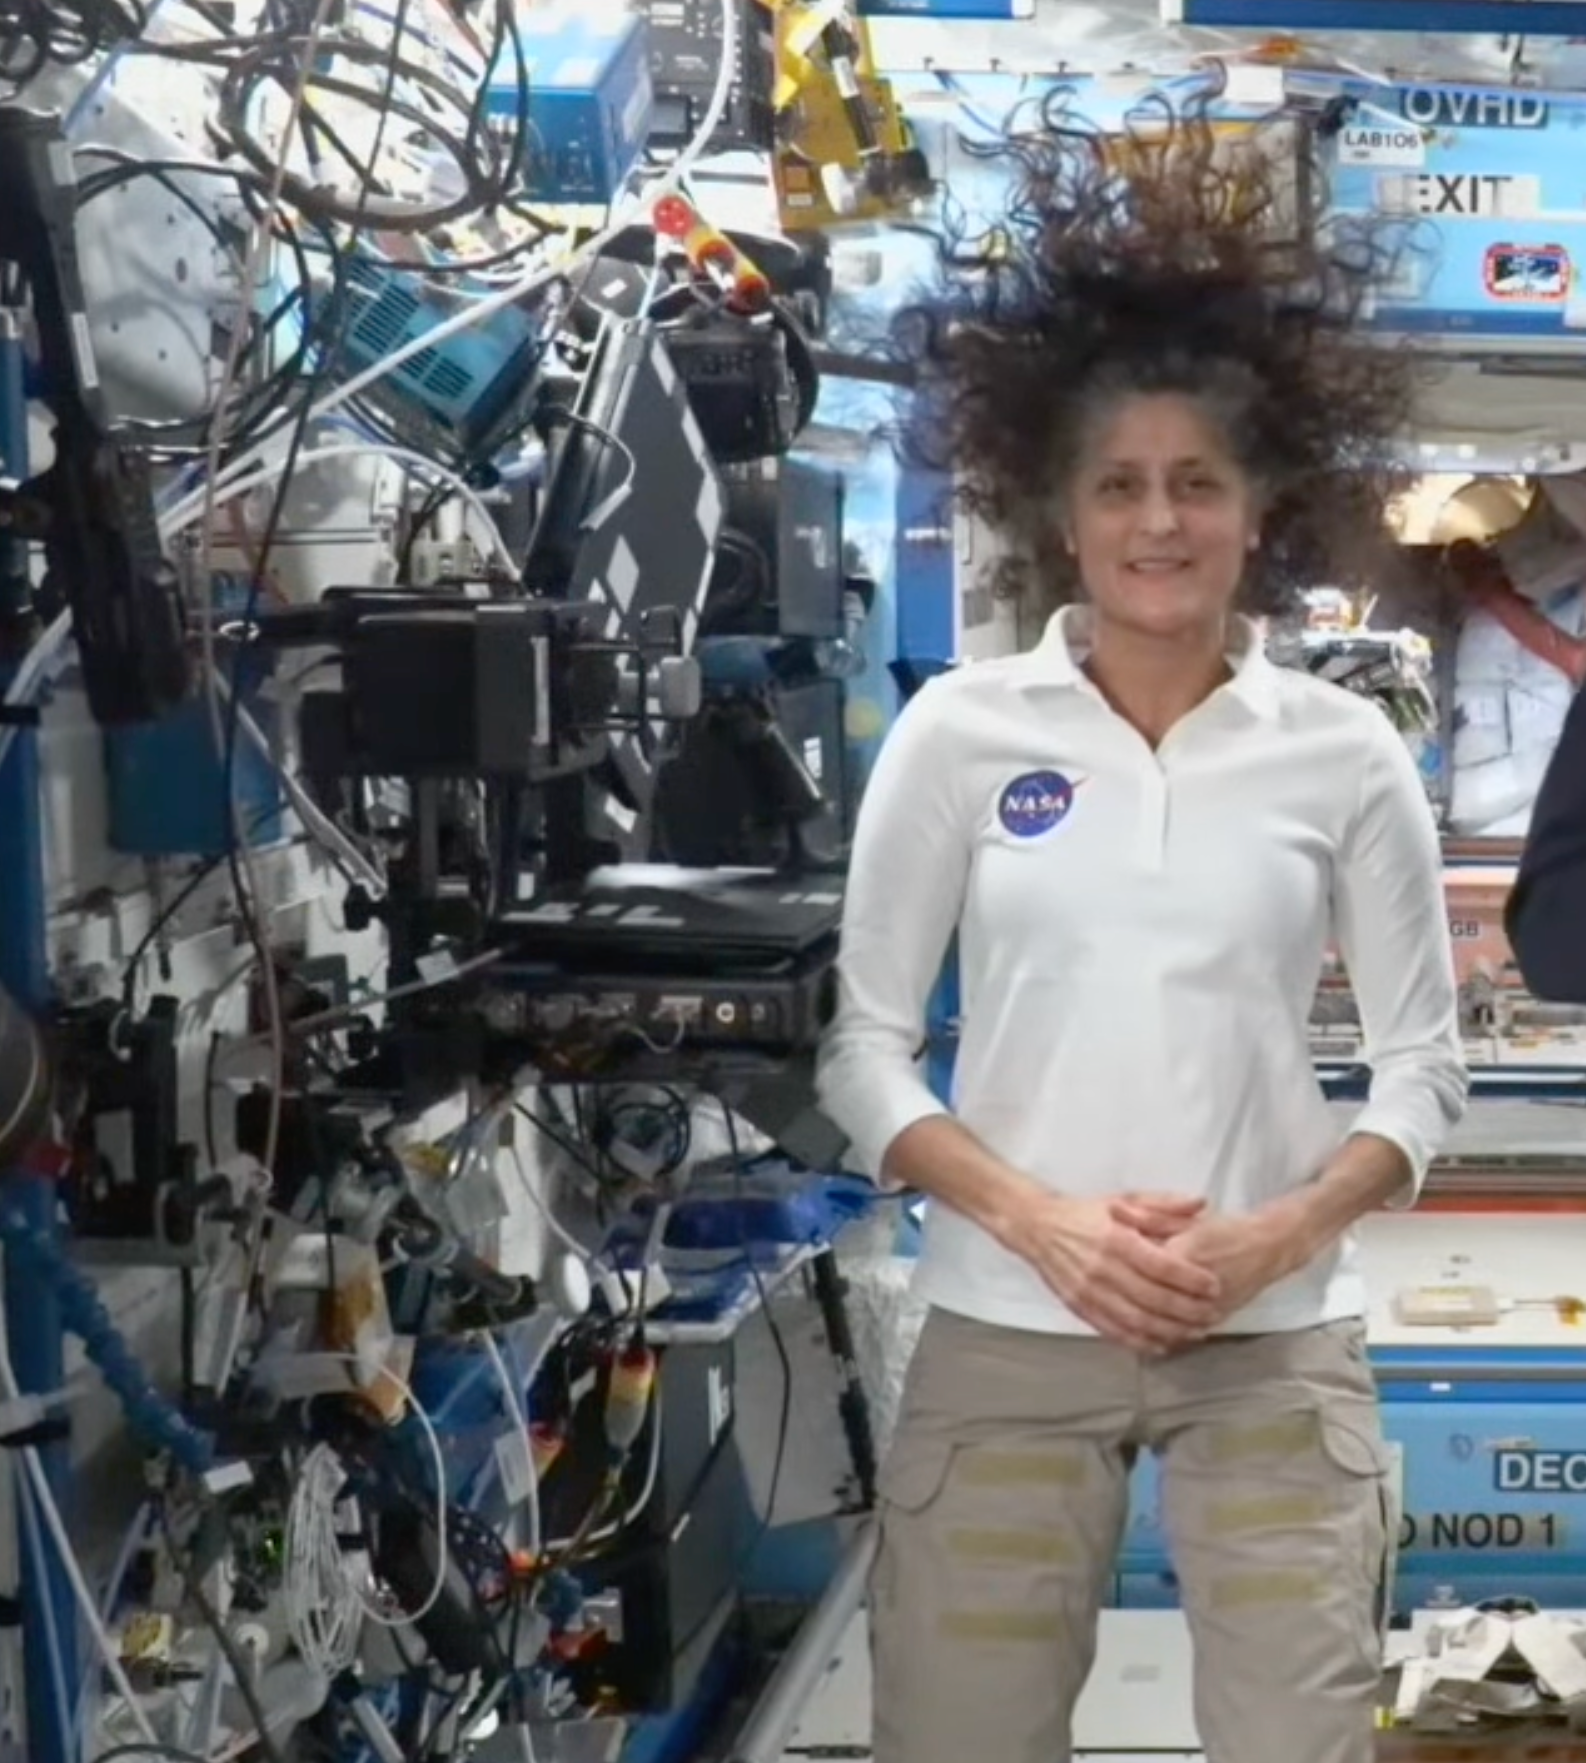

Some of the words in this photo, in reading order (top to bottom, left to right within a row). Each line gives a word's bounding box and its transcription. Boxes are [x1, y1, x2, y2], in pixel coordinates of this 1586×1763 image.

[1403, 175, 1513, 213] EXIT
[1005, 795, 1065, 811] NASA
[1432, 1513, 1524, 1548] NOD
[1540, 1513, 1556, 1547] 1
